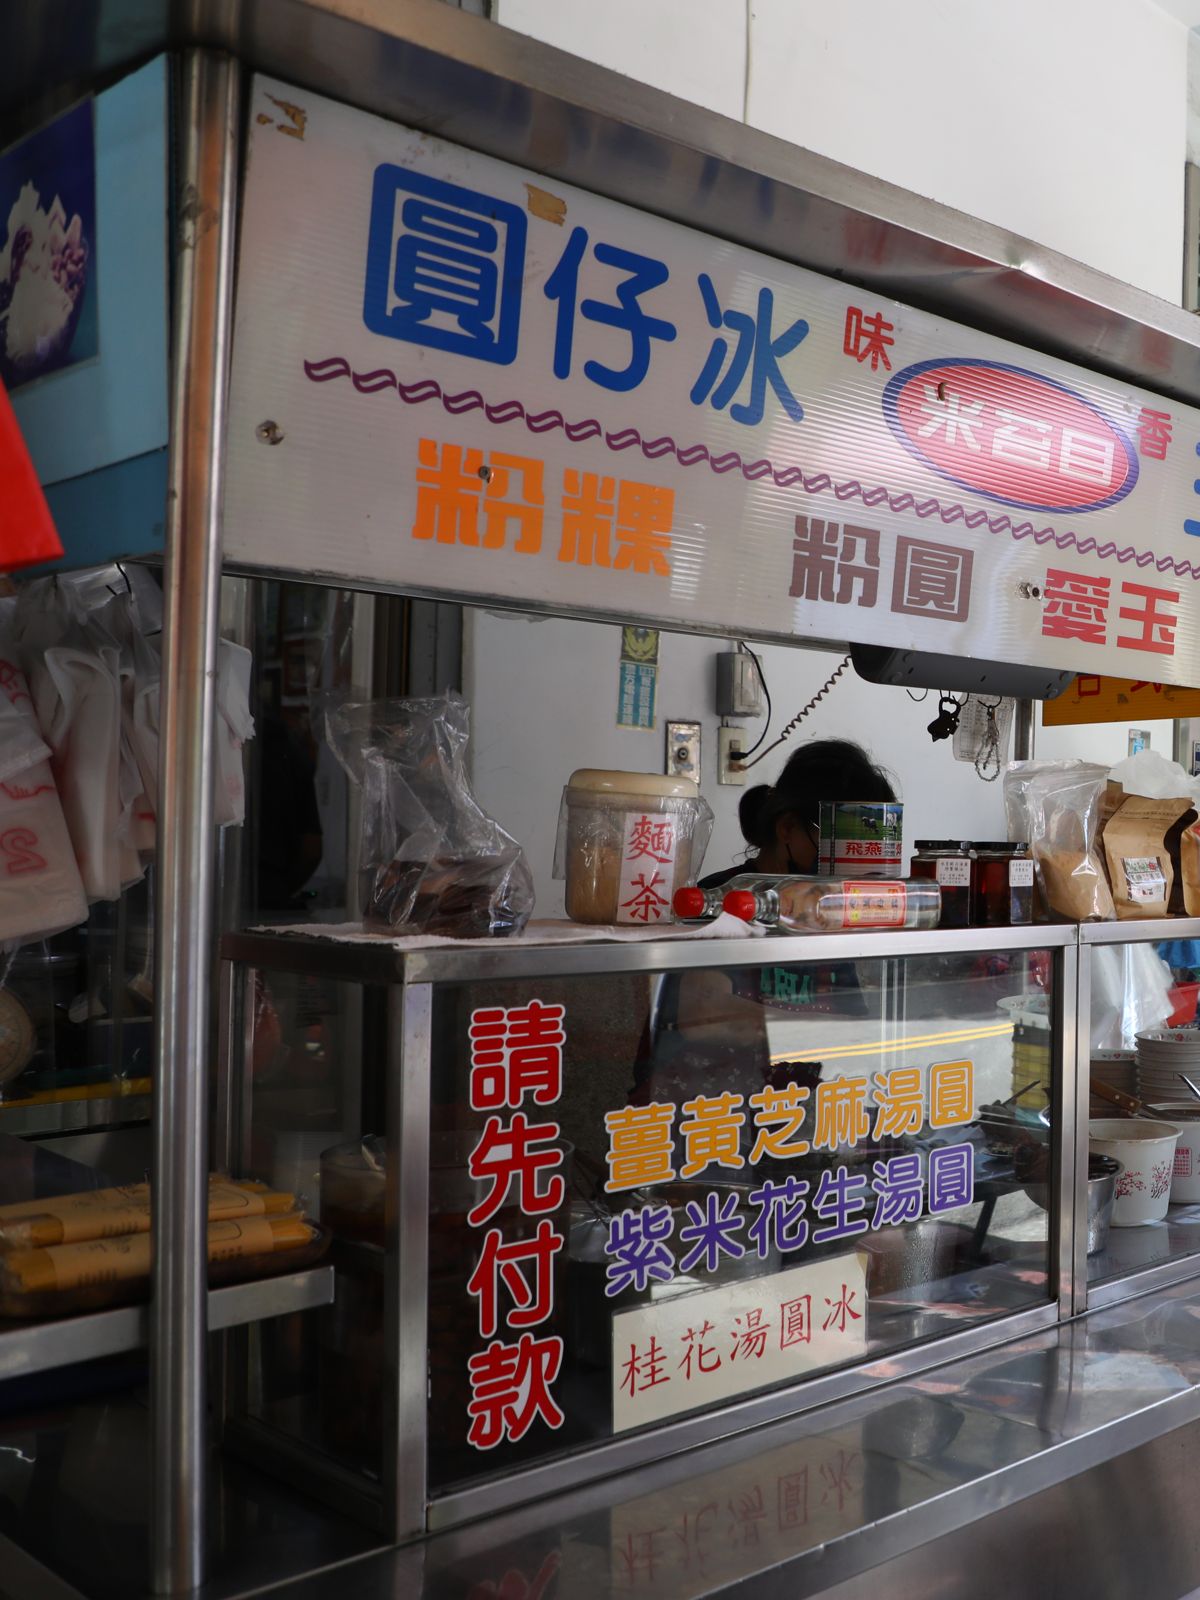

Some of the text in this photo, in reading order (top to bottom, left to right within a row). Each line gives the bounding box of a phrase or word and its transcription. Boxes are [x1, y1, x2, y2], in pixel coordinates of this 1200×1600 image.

[362, 162, 810, 427] 圓仔冰
[843, 305, 895, 371] 味
[1136, 407, 1173, 460] 香
[411, 438, 675, 577] 粉粿
[789, 514, 975, 623] 粉圓
[1042, 567, 1181, 656] 愛玉
[621, 815, 673, 922] 麵茶
[604, 1058, 975, 1193] 薑黃芝麻湯圓
[466, 999, 566, 1450] 請先付款
[604, 1142, 975, 1298] 紫米花生湯圓
[619, 1285, 863, 1399] 桂花湯圓冰
